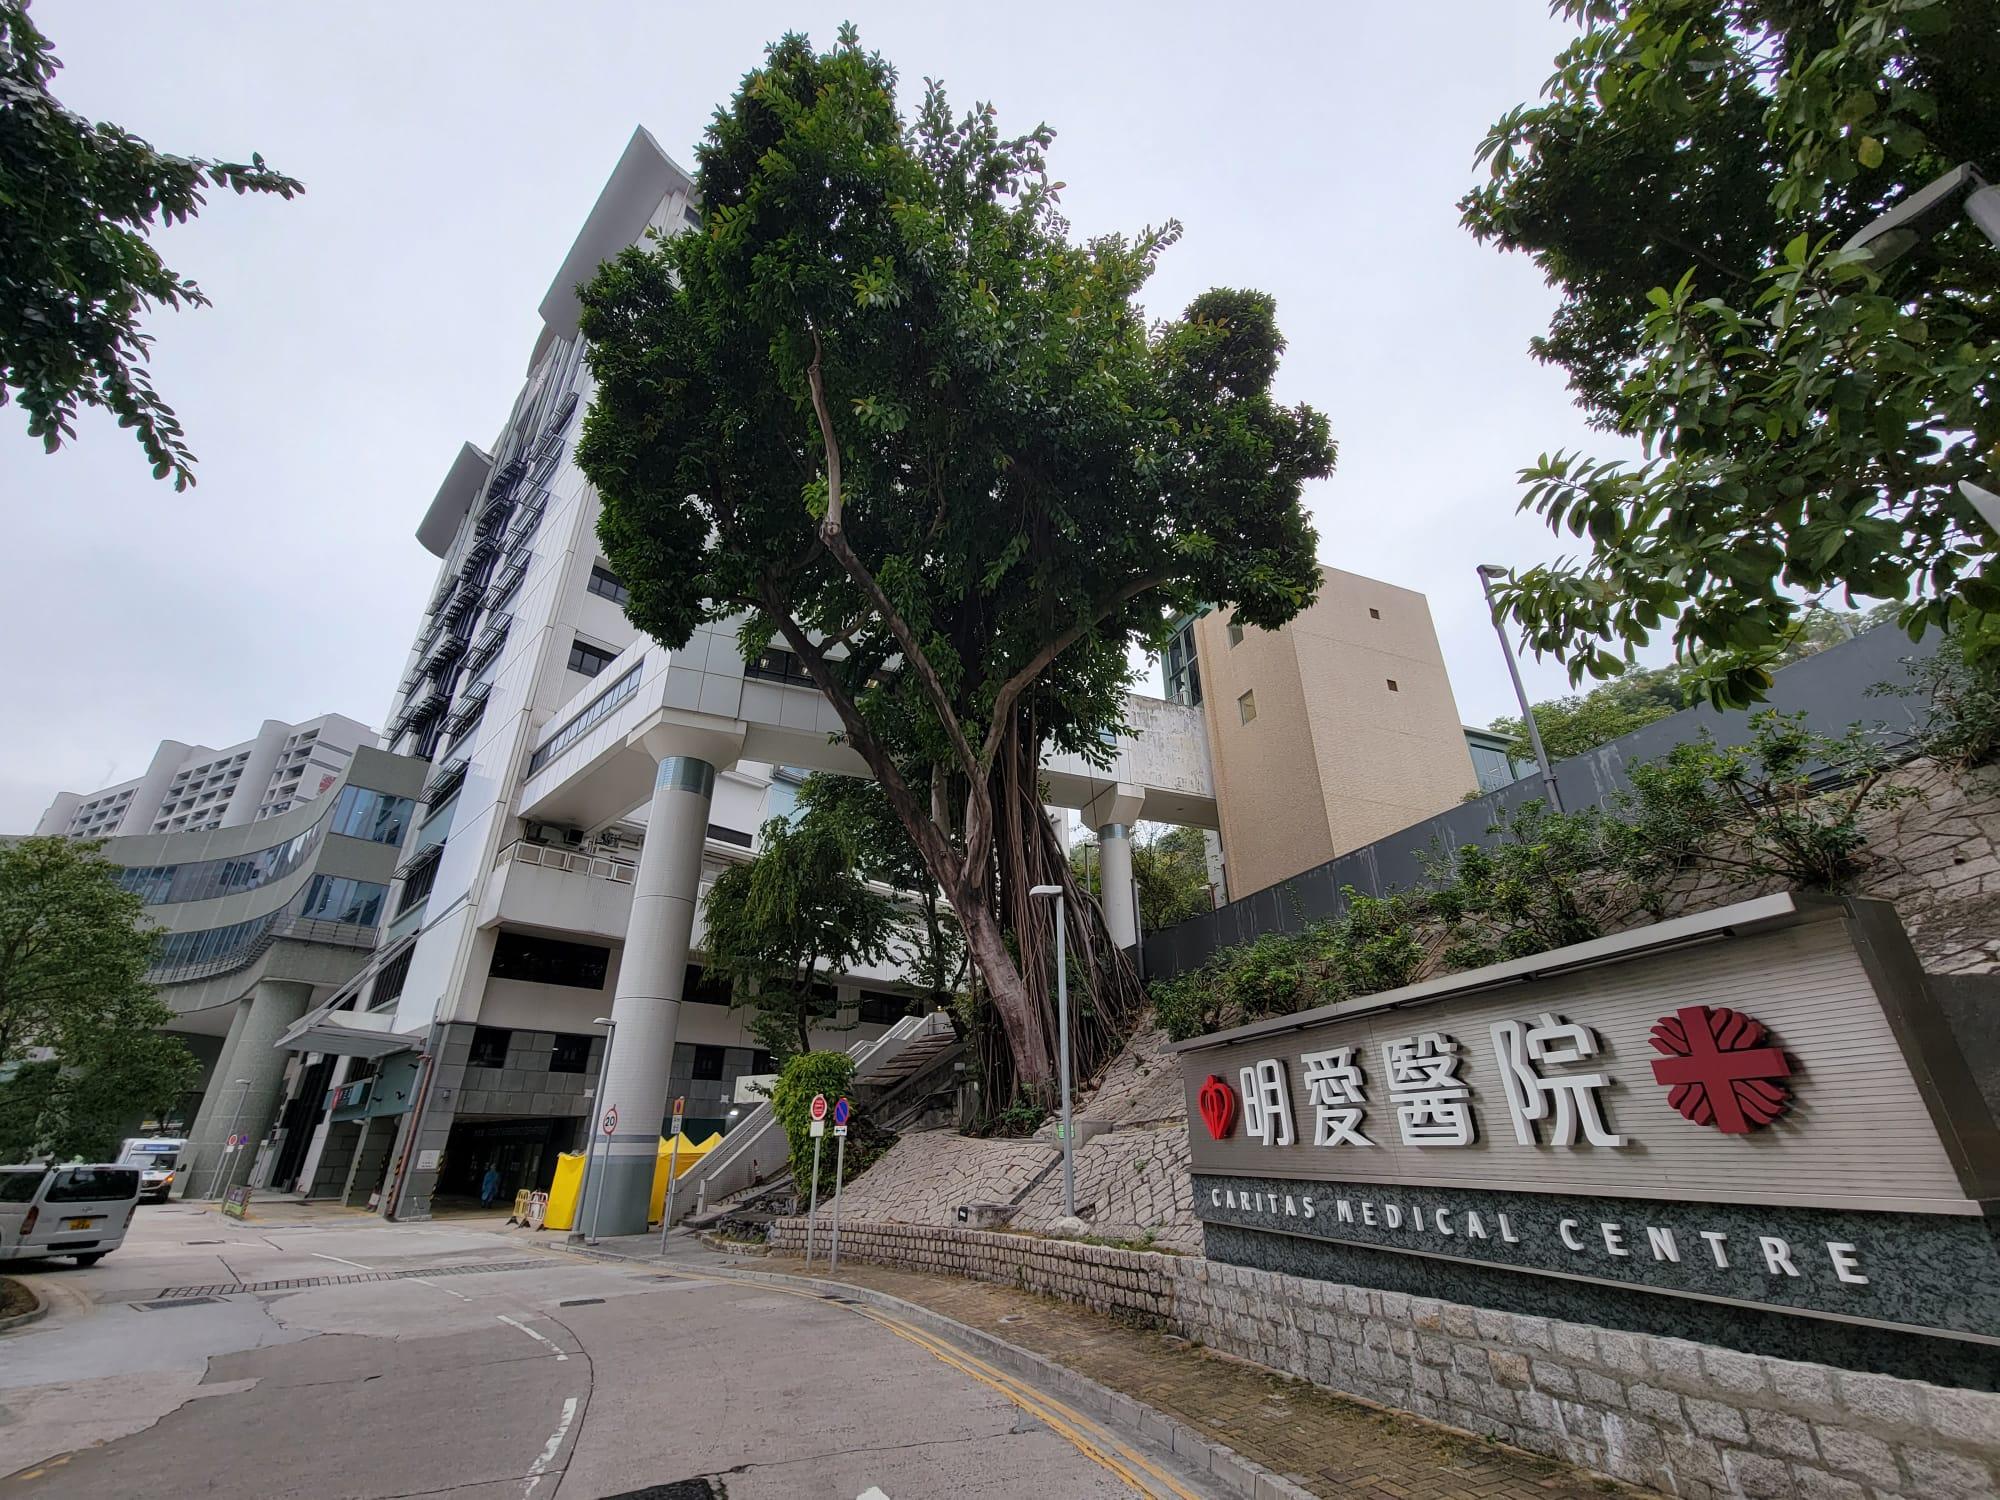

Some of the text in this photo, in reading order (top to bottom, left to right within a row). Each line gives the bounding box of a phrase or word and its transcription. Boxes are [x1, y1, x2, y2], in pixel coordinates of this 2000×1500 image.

[1239, 1013, 1628, 1148] 明愛醫院
[1211, 1188, 1870, 1285] CARITAS MEDICAL CENTRE
